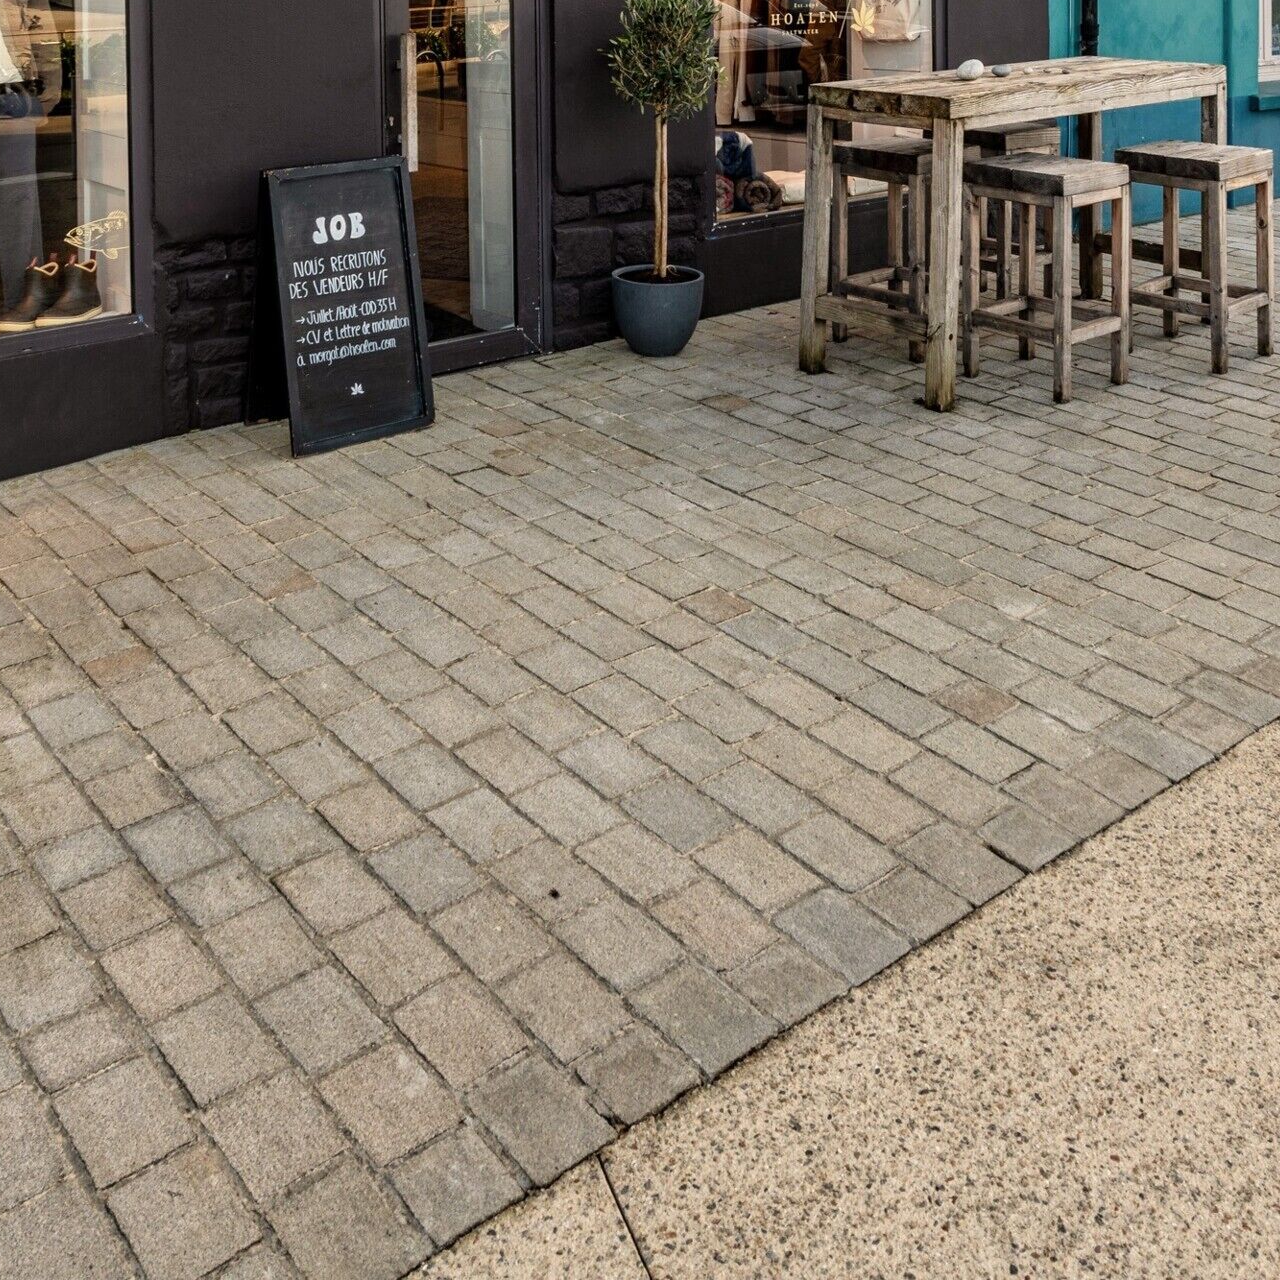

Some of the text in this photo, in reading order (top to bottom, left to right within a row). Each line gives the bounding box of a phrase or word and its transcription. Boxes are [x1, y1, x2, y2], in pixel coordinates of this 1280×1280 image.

[770, 10, 839, 26] HOALEN
[312, 212, 366, 245] JOB
[293, 249, 387, 278] NOUS RECRUTONS
[289, 269, 389, 300] DES VENDEURS H/F
[306, 308, 335, 325] Juillet
[306, 315, 410, 345] CV et Lettre de motivation
